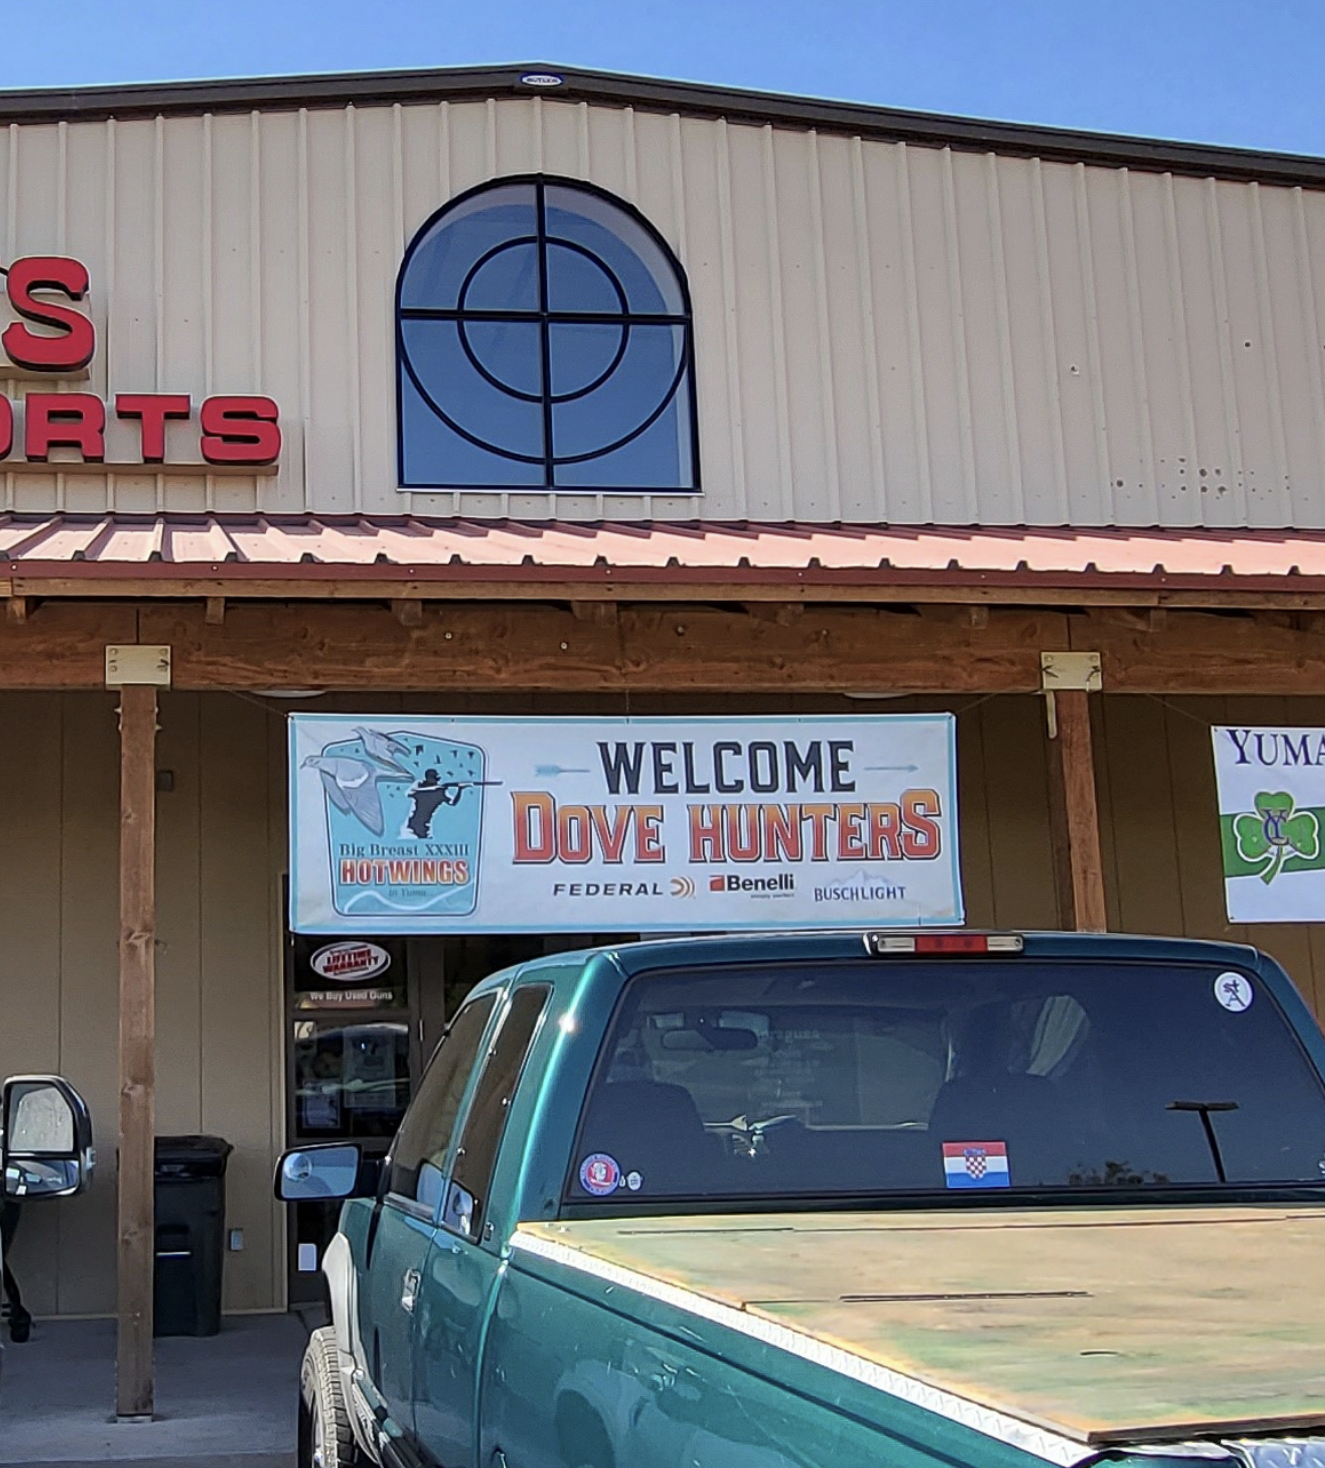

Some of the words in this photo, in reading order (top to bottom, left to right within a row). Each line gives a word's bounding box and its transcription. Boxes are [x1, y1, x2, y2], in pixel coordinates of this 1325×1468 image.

[597, 741, 856, 794] WELCOME
[511, 791, 666, 864] DOVE
[687, 788, 942, 863] HUNTERS
[340, 843, 365, 857] Big
[370, 843, 418, 856] Breast
[425, 843, 468, 856] XXXIII
[339, 858, 471, 885] HOTWINGS
[553, 882, 663, 896] FEDERAL
[727, 874, 794, 891] Benelli
[310, 992, 323, 1000] We
[326, 992, 343, 1002] Buy
[345, 991, 367, 1000] Used
